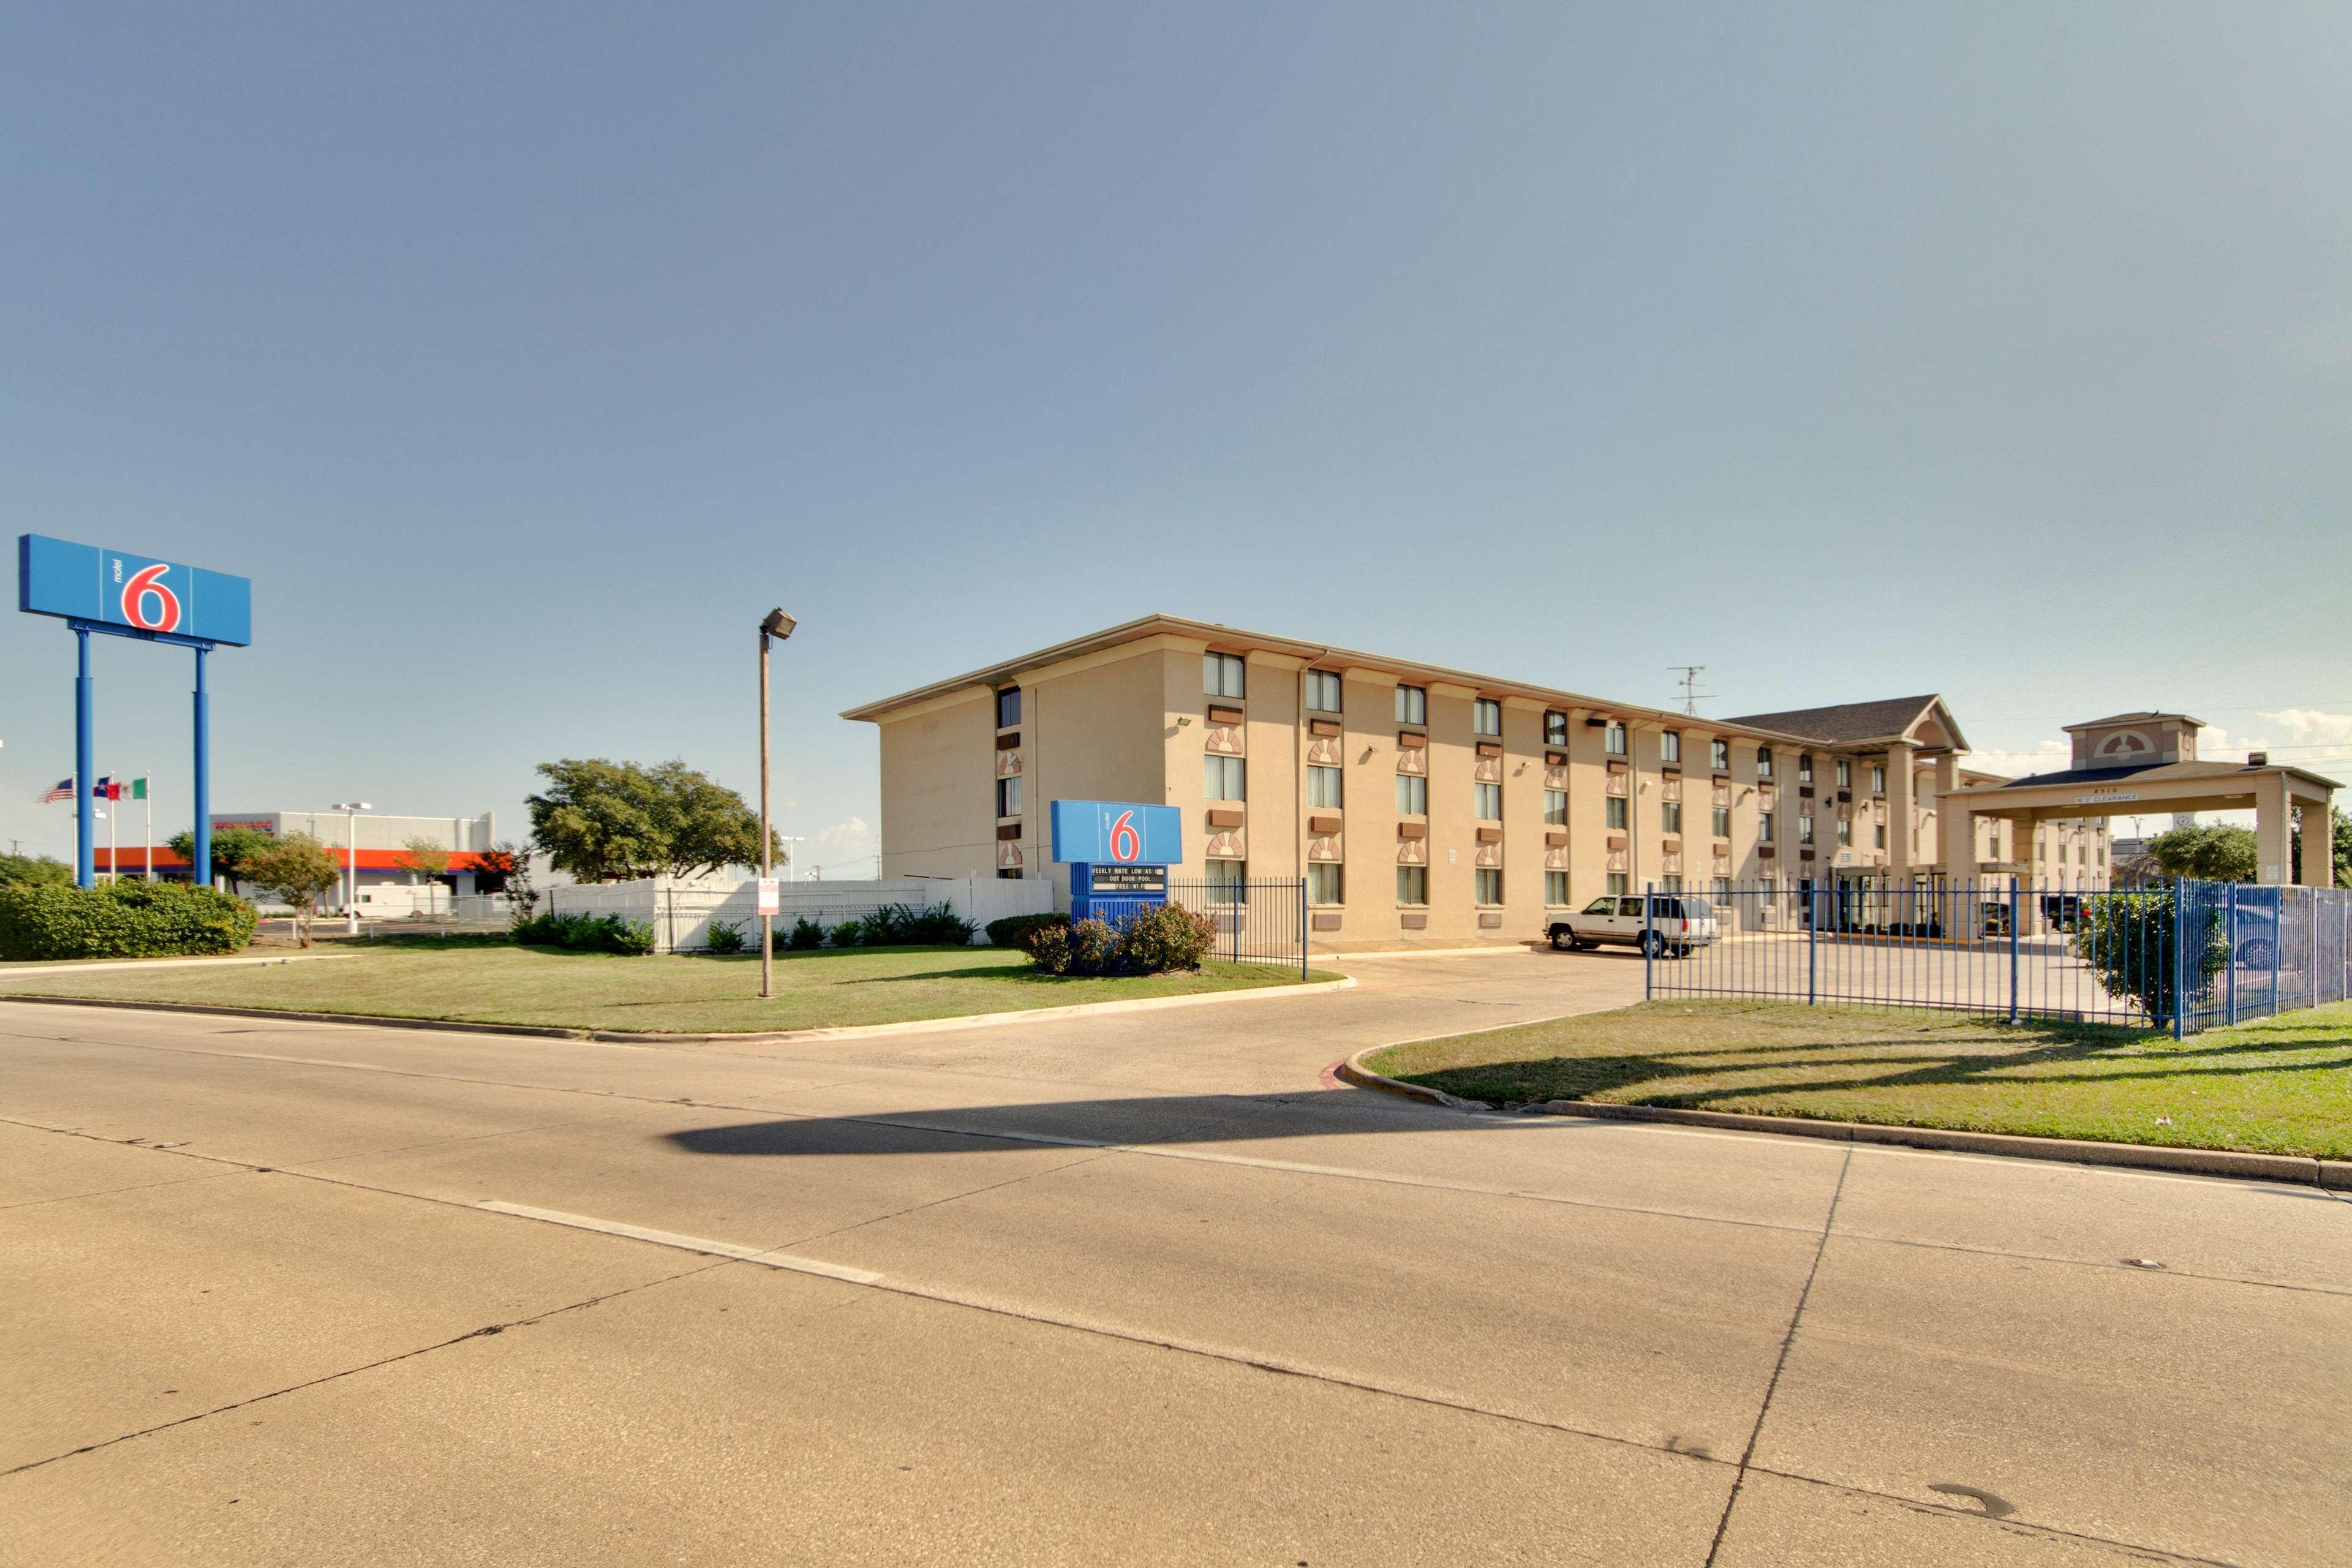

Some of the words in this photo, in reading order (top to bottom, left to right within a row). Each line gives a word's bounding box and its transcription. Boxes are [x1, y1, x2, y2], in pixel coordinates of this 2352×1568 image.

[112, 558, 123, 584] motel
[121, 564, 181, 633] 6
[1109, 810, 1140, 862] 6
